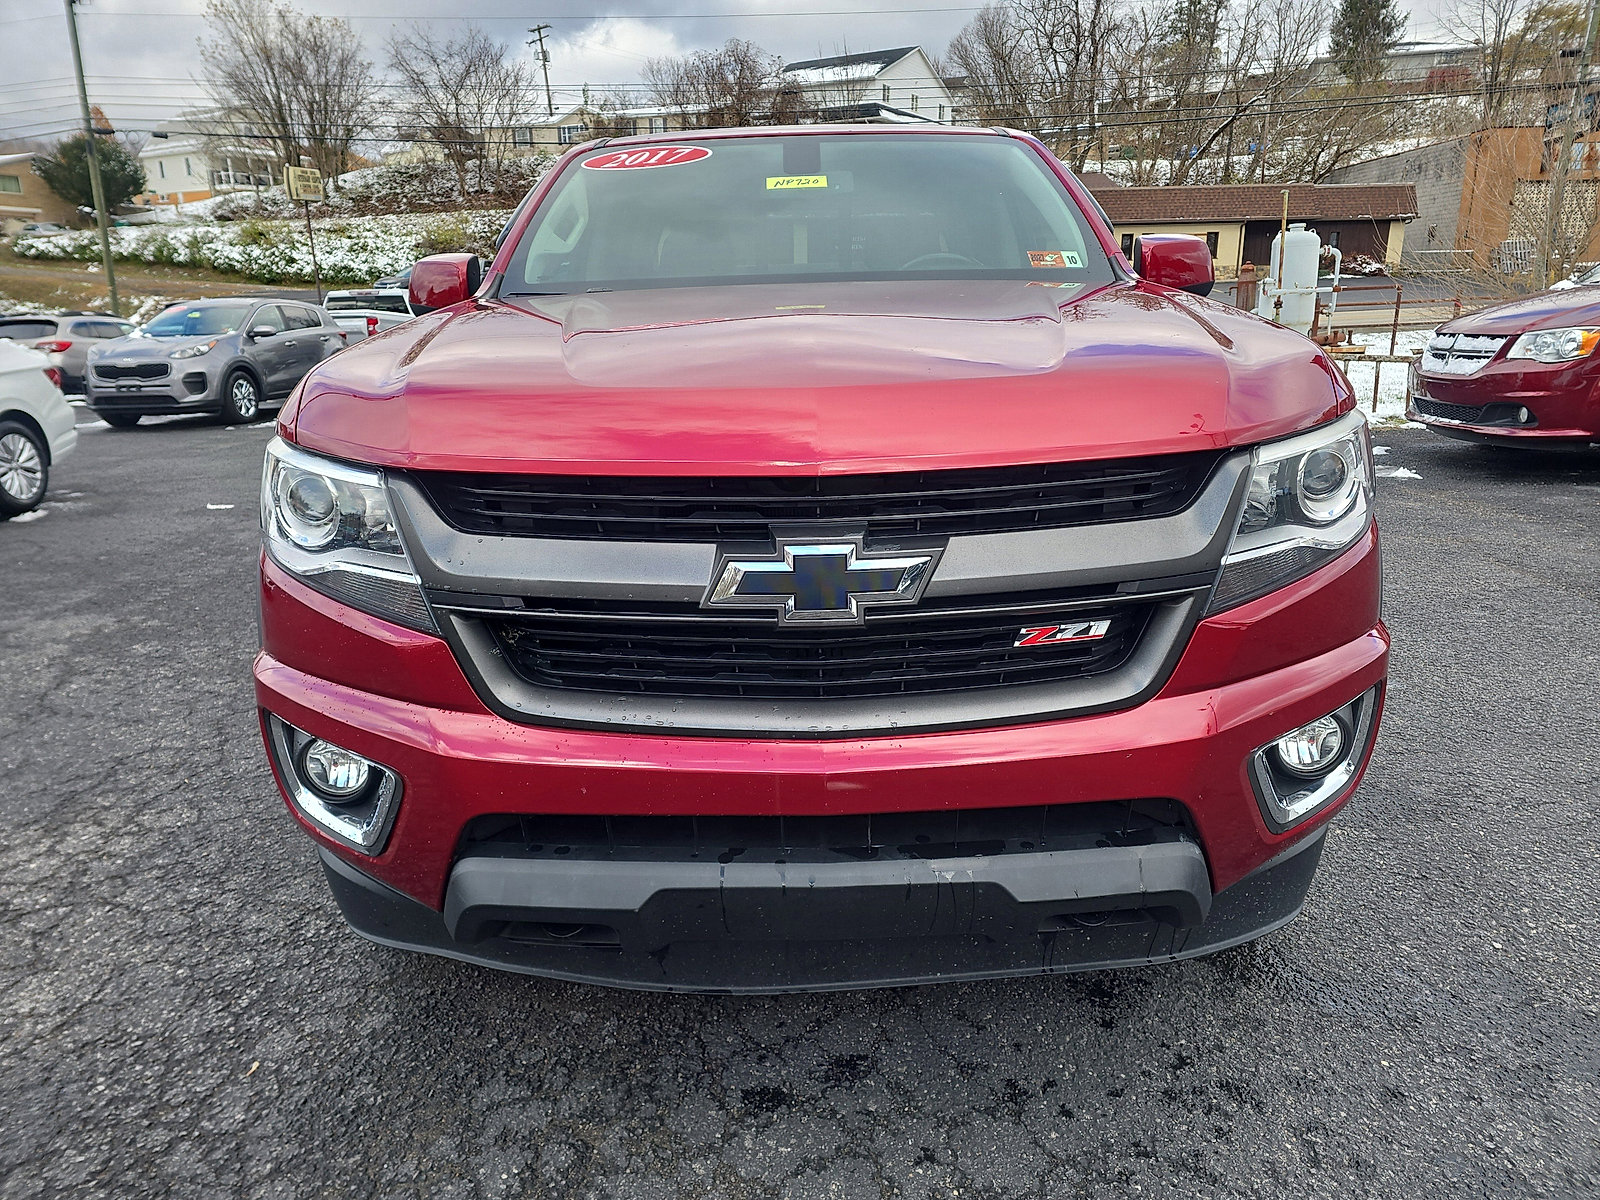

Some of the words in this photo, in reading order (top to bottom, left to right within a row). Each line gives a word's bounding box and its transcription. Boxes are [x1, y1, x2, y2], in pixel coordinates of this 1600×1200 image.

[600, 148, 694, 168] 2017
[1066, 255, 1078, 265] 10
[1013, 619, 1112, 647] Z71
